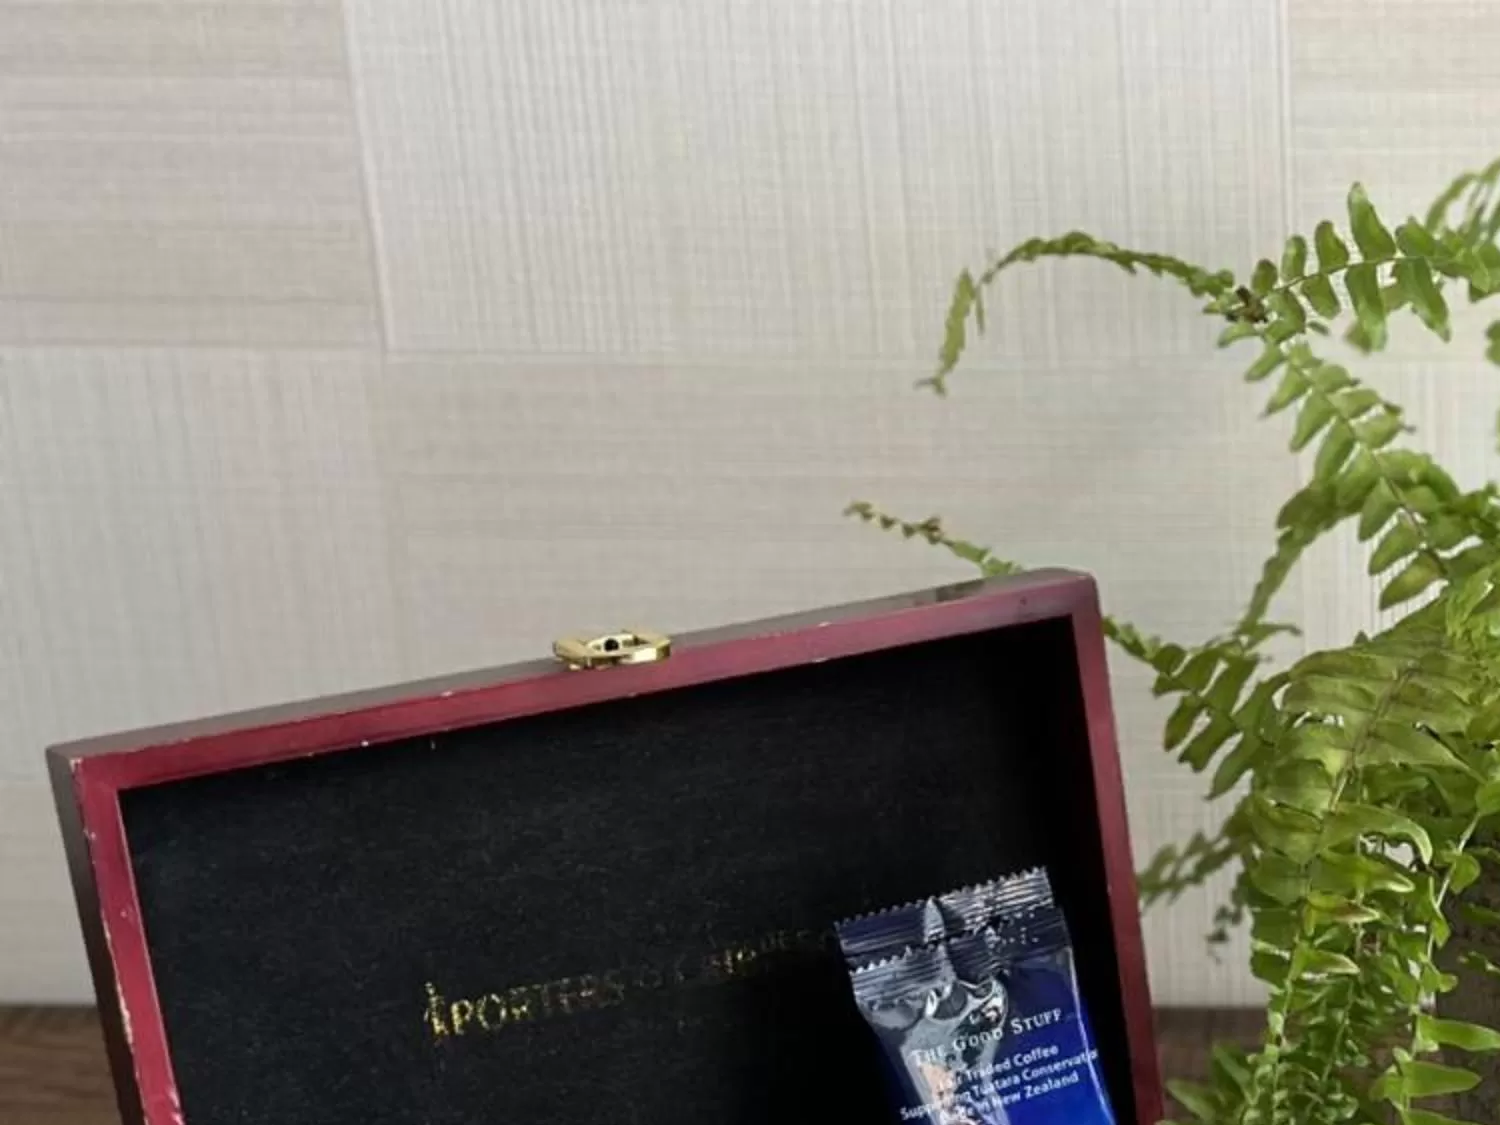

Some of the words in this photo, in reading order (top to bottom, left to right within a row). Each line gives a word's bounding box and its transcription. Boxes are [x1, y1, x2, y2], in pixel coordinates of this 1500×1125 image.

[1009, 1007, 1062, 1036] STUFF
[1013, 1044, 1060, 1068] Coffee
[1023, 1069, 1080, 1098] Zealand
